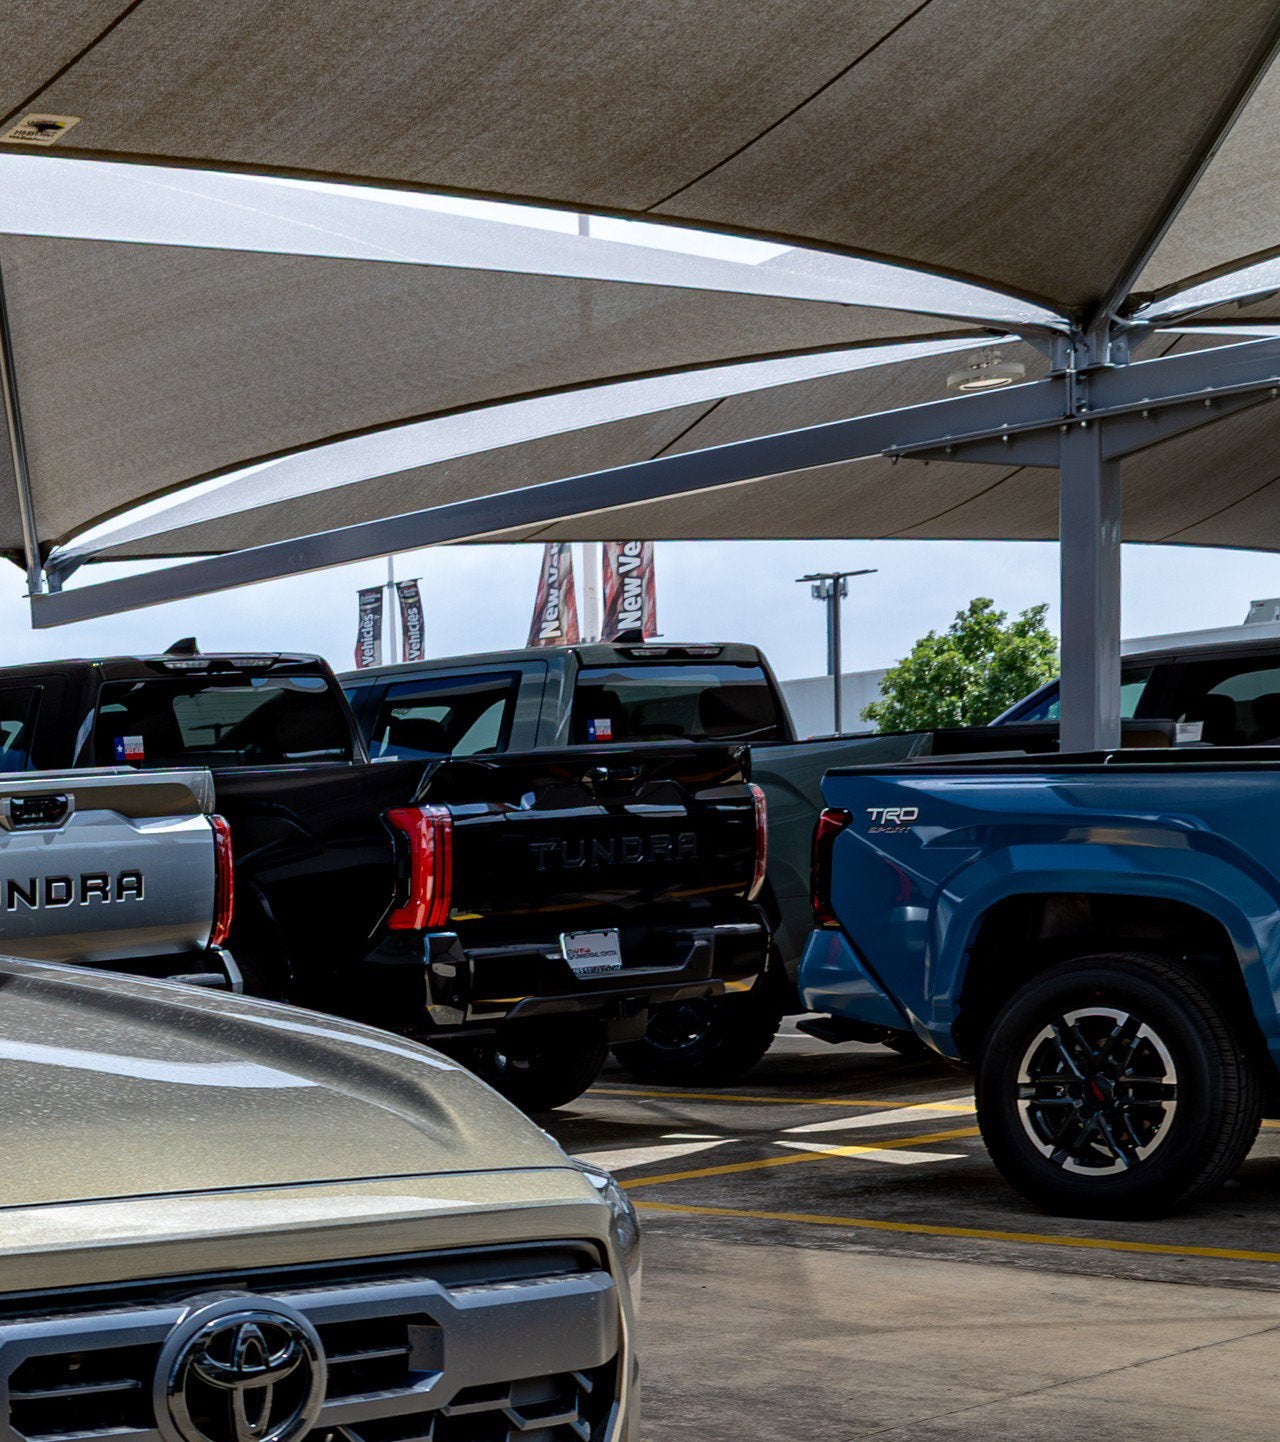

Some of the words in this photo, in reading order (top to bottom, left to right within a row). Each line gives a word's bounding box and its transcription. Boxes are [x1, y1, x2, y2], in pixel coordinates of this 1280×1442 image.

[538, 588, 562, 639] New
[617, 577, 643, 630] New
[360, 612, 376, 666] Vehicles
[406, 606, 421, 660] Vehicles
[866, 807, 919, 825] TRD
[528, 832, 698, 872] TUNDRA
